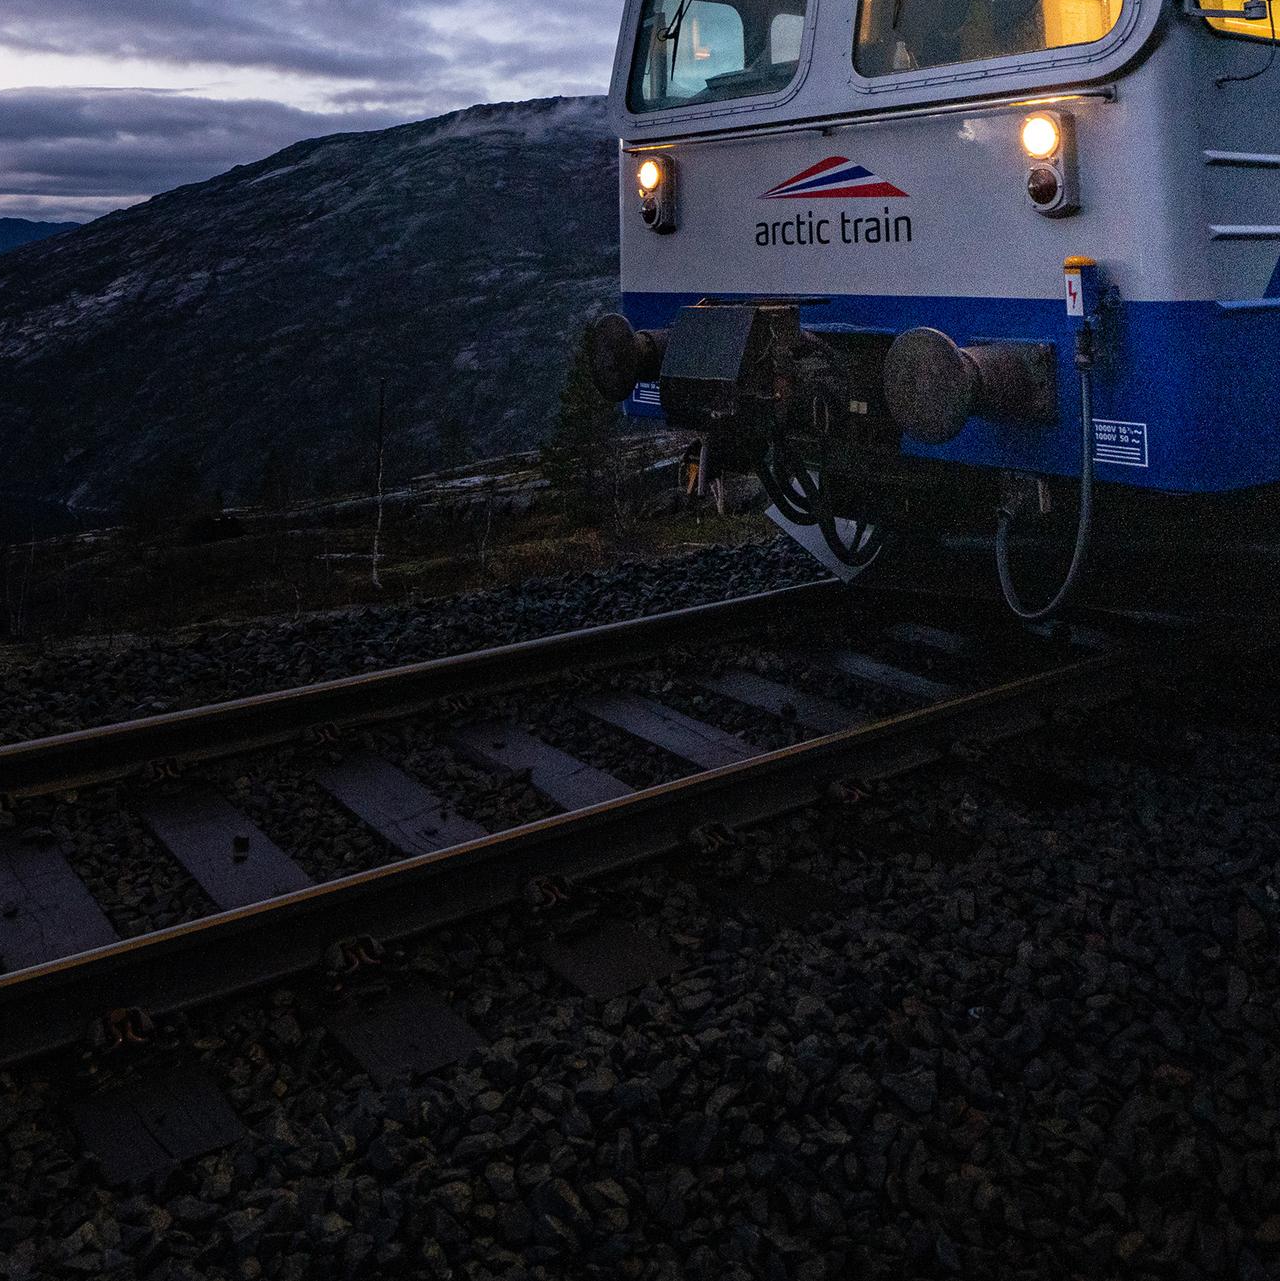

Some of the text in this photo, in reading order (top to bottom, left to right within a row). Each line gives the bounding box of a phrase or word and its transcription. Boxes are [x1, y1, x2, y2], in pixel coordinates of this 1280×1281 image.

[755, 206, 912, 246] arctic train
[1094, 423, 1117, 433] 1000V
[1094, 432, 1130, 443] 1000V 50
